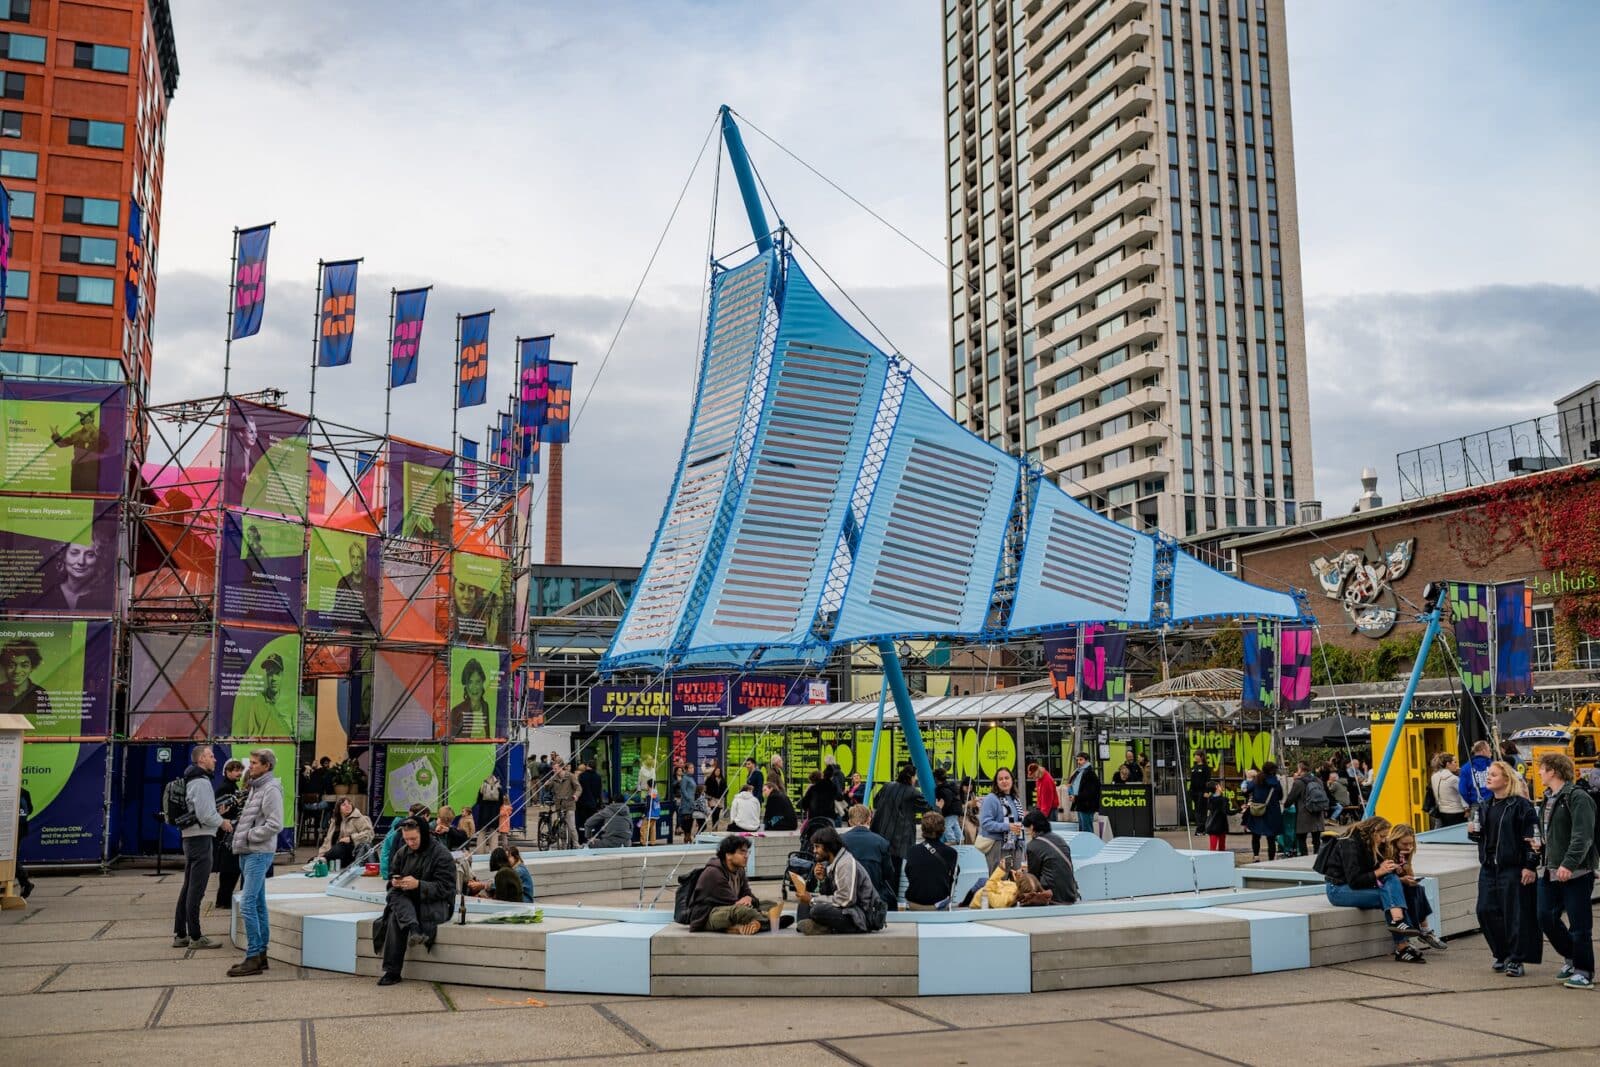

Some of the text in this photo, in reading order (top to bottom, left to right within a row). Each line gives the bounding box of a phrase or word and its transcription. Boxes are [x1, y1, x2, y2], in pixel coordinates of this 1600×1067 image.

[1533, 570, 1596, 594] telhuis
[677, 681, 725, 693] FUTURE
[741, 682, 786, 697] FUTURE
[683, 693, 721, 704] DESIGN
[747, 696, 784, 709] DESIGN
[602, 705, 670, 716] BY DESIGN
[1189, 730, 1232, 749] Unfair
[1190, 749, 1221, 772] Pay
[22, 766, 51, 774] dition
